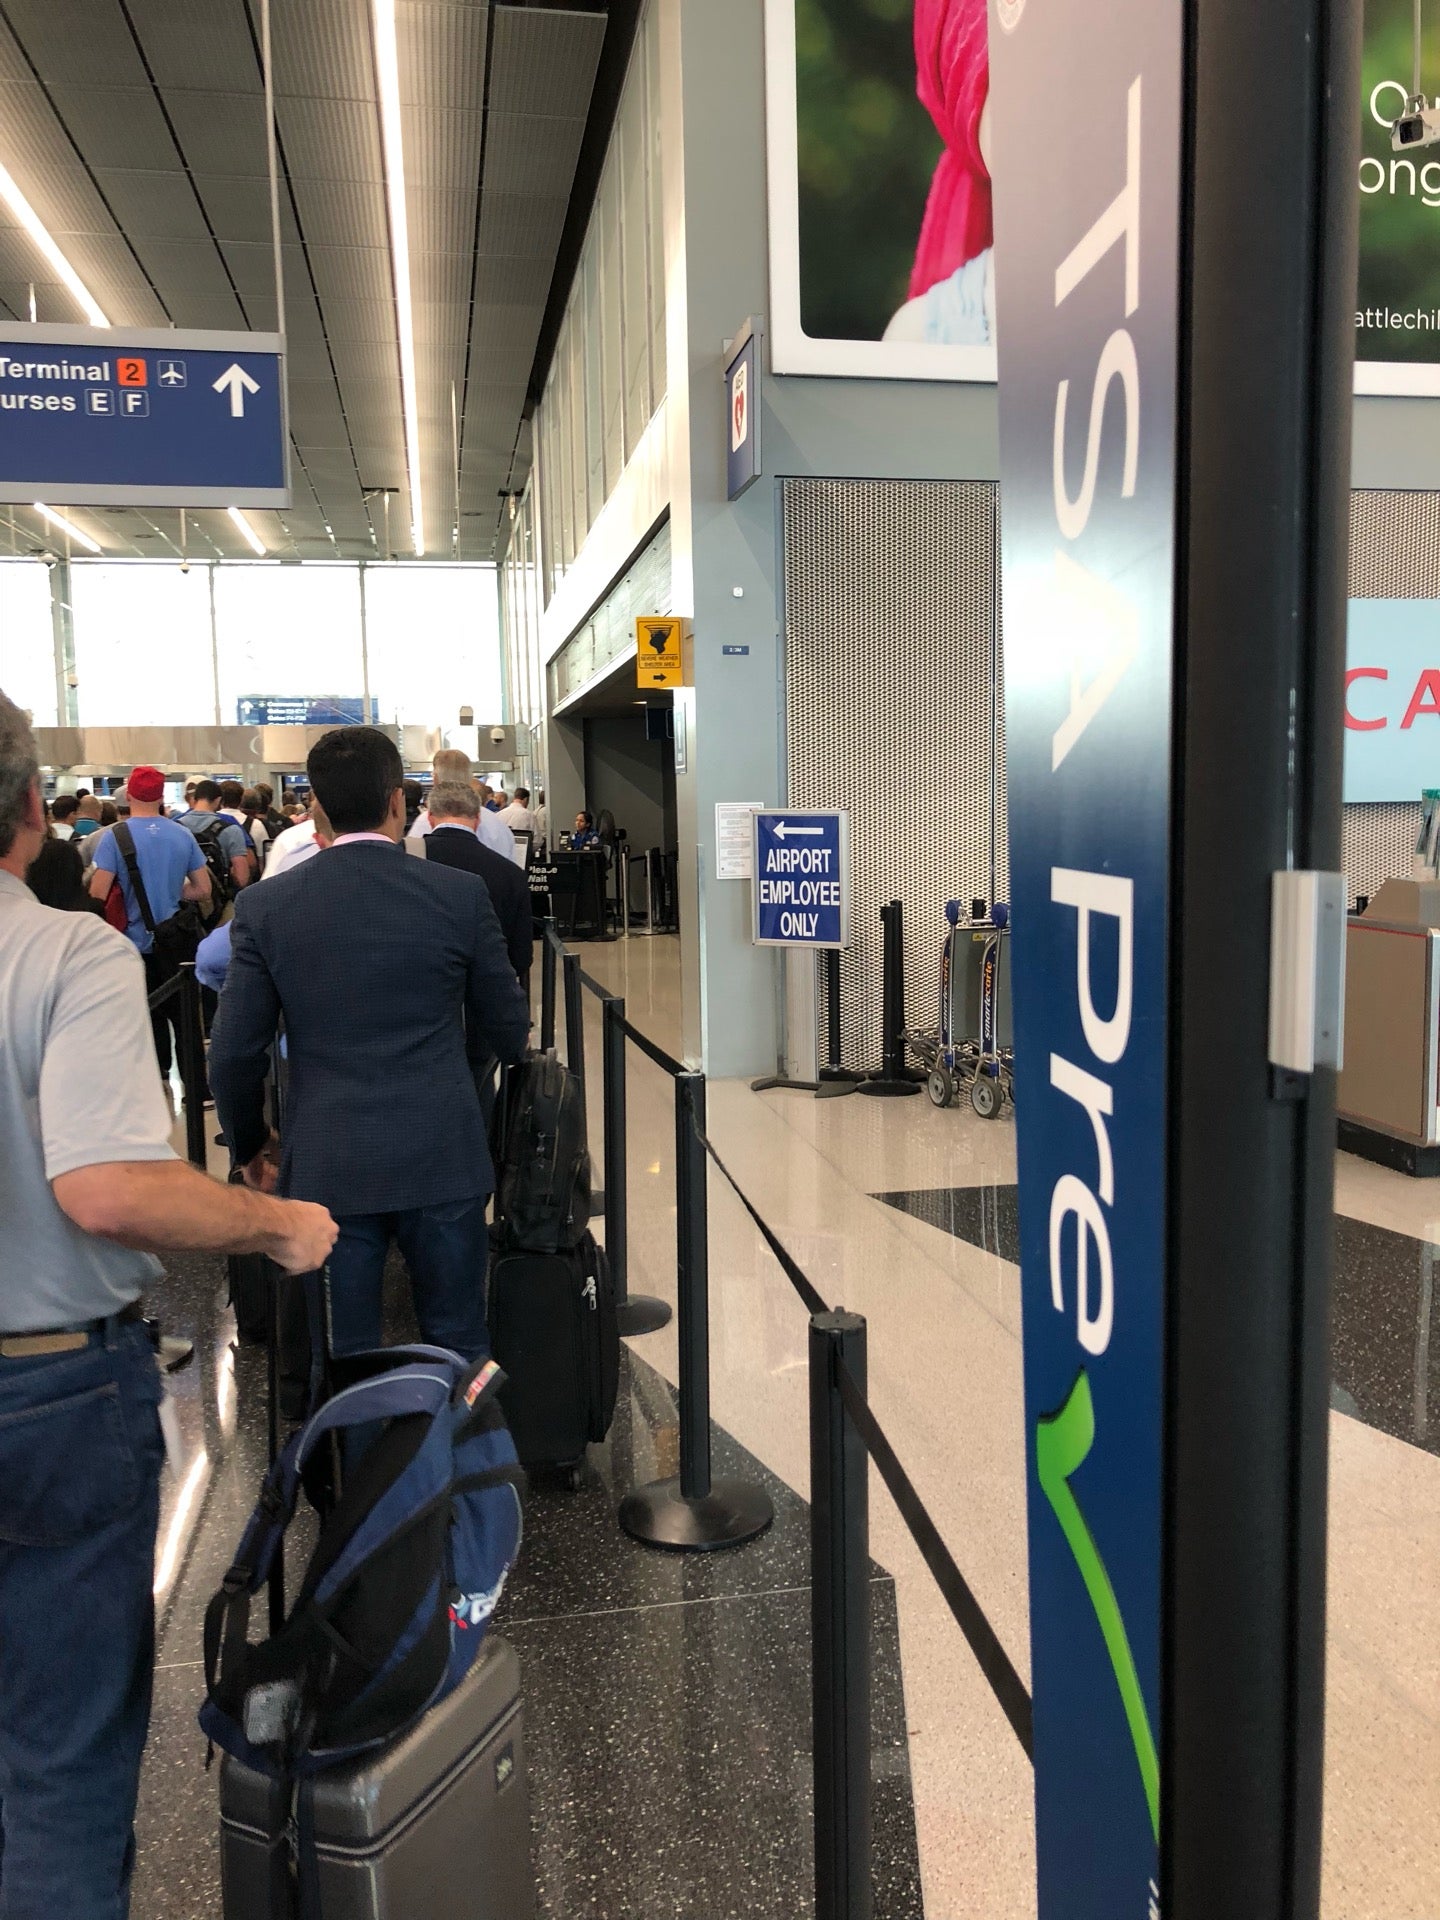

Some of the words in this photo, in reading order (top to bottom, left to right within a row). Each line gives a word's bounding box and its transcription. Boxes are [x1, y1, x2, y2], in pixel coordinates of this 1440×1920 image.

[0, 357, 110, 381] Terminal
[125, 363, 140, 382] 2
[1, 393, 76, 412] urses
[92, 392, 109, 412] E
[127, 393, 142, 413] F
[1052, 73, 1142, 773] TSA
[766, 848, 832, 873] AIRPORT
[760, 880, 840, 906] EMPLOYEE
[780, 911, 819, 937] ONLY
[1050, 866, 1134, 1356] Pre
